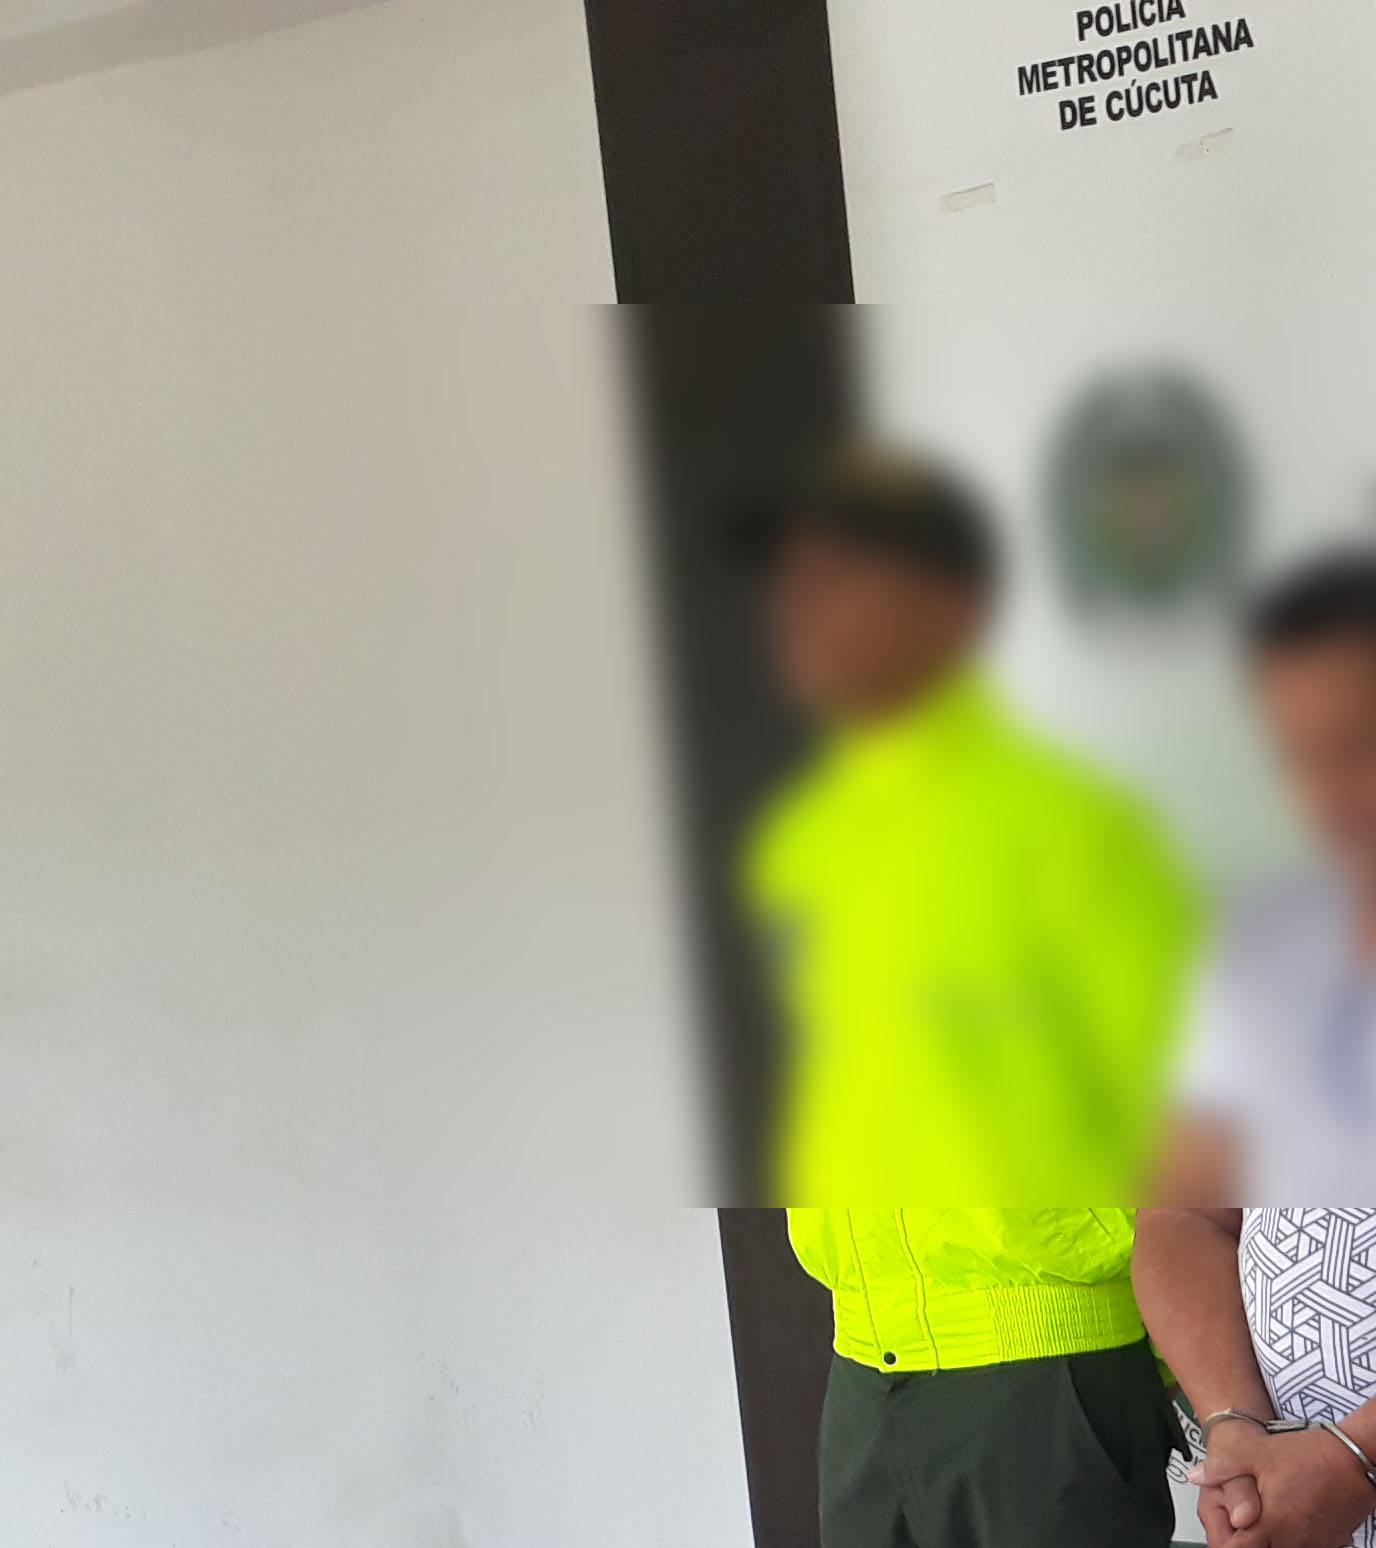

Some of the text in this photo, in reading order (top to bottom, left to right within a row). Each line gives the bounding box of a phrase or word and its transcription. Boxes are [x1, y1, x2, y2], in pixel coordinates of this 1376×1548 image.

[1017, 18, 1254, 96] METROPOLITANA
[1058, 70, 1219, 131] DE CÚCUTA
